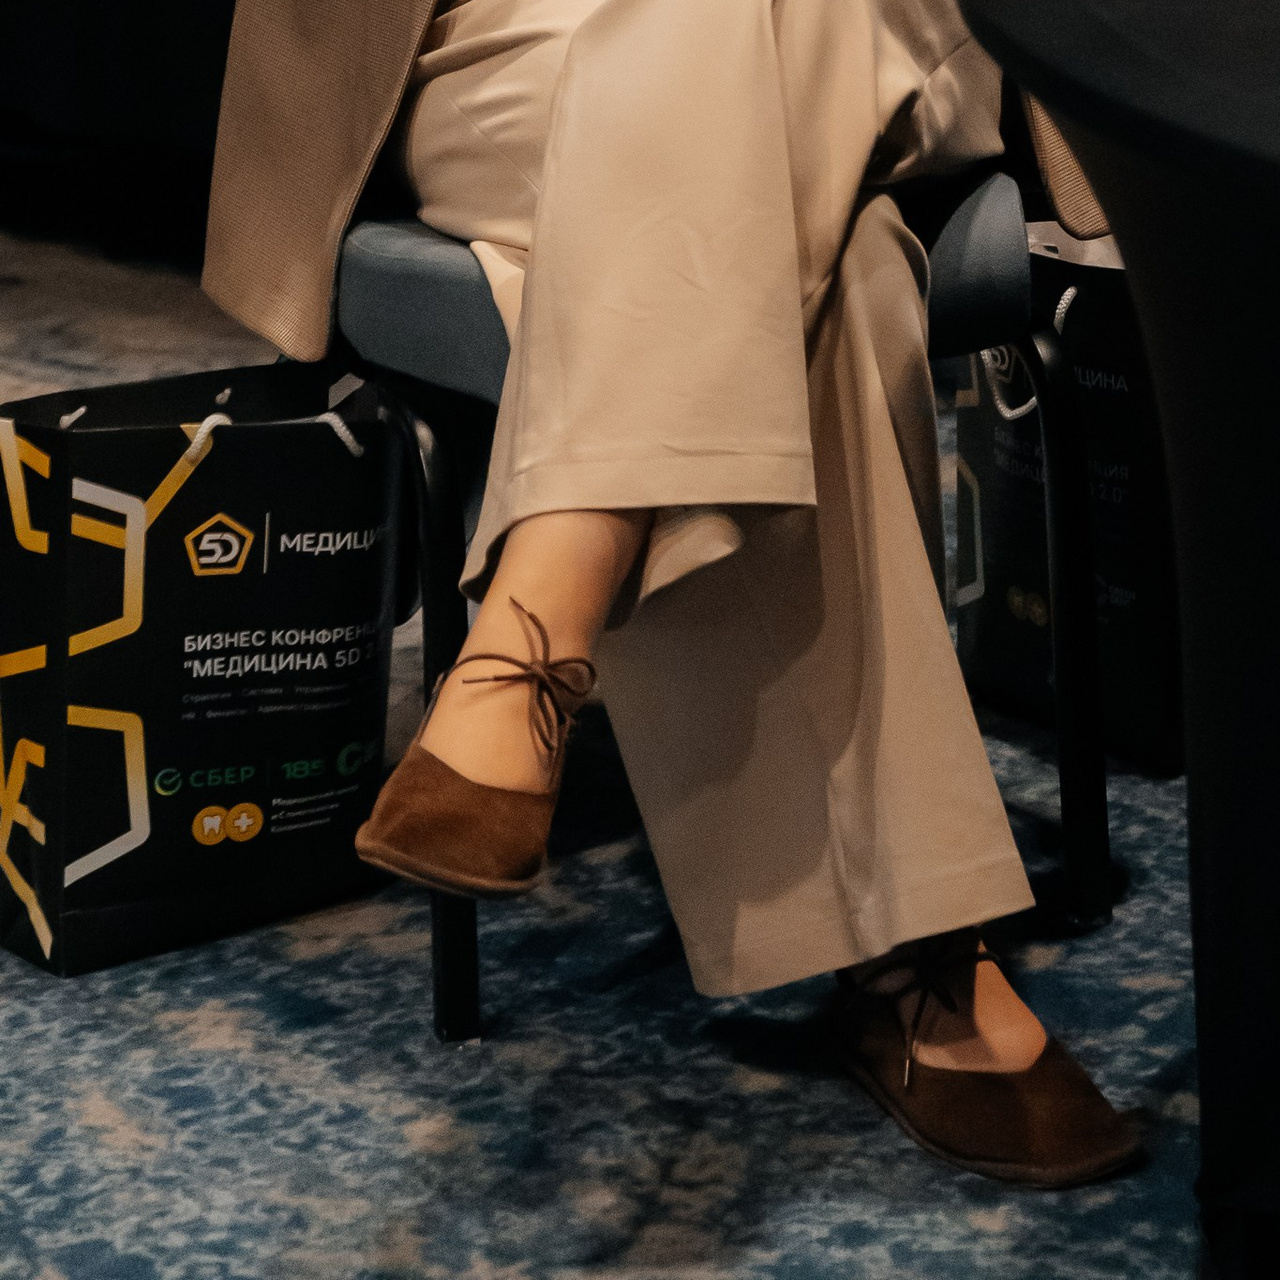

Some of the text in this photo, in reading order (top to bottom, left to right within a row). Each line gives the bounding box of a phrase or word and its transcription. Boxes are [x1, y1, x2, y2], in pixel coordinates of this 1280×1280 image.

[198, 532, 241, 564] 5D
[184, 630, 267, 653] БИЗНЕС
[183, 652, 328, 679] "МЕДИЦИНА
[334, 647, 361, 669] 5D
[188, 765, 256, 788] СБЕР
